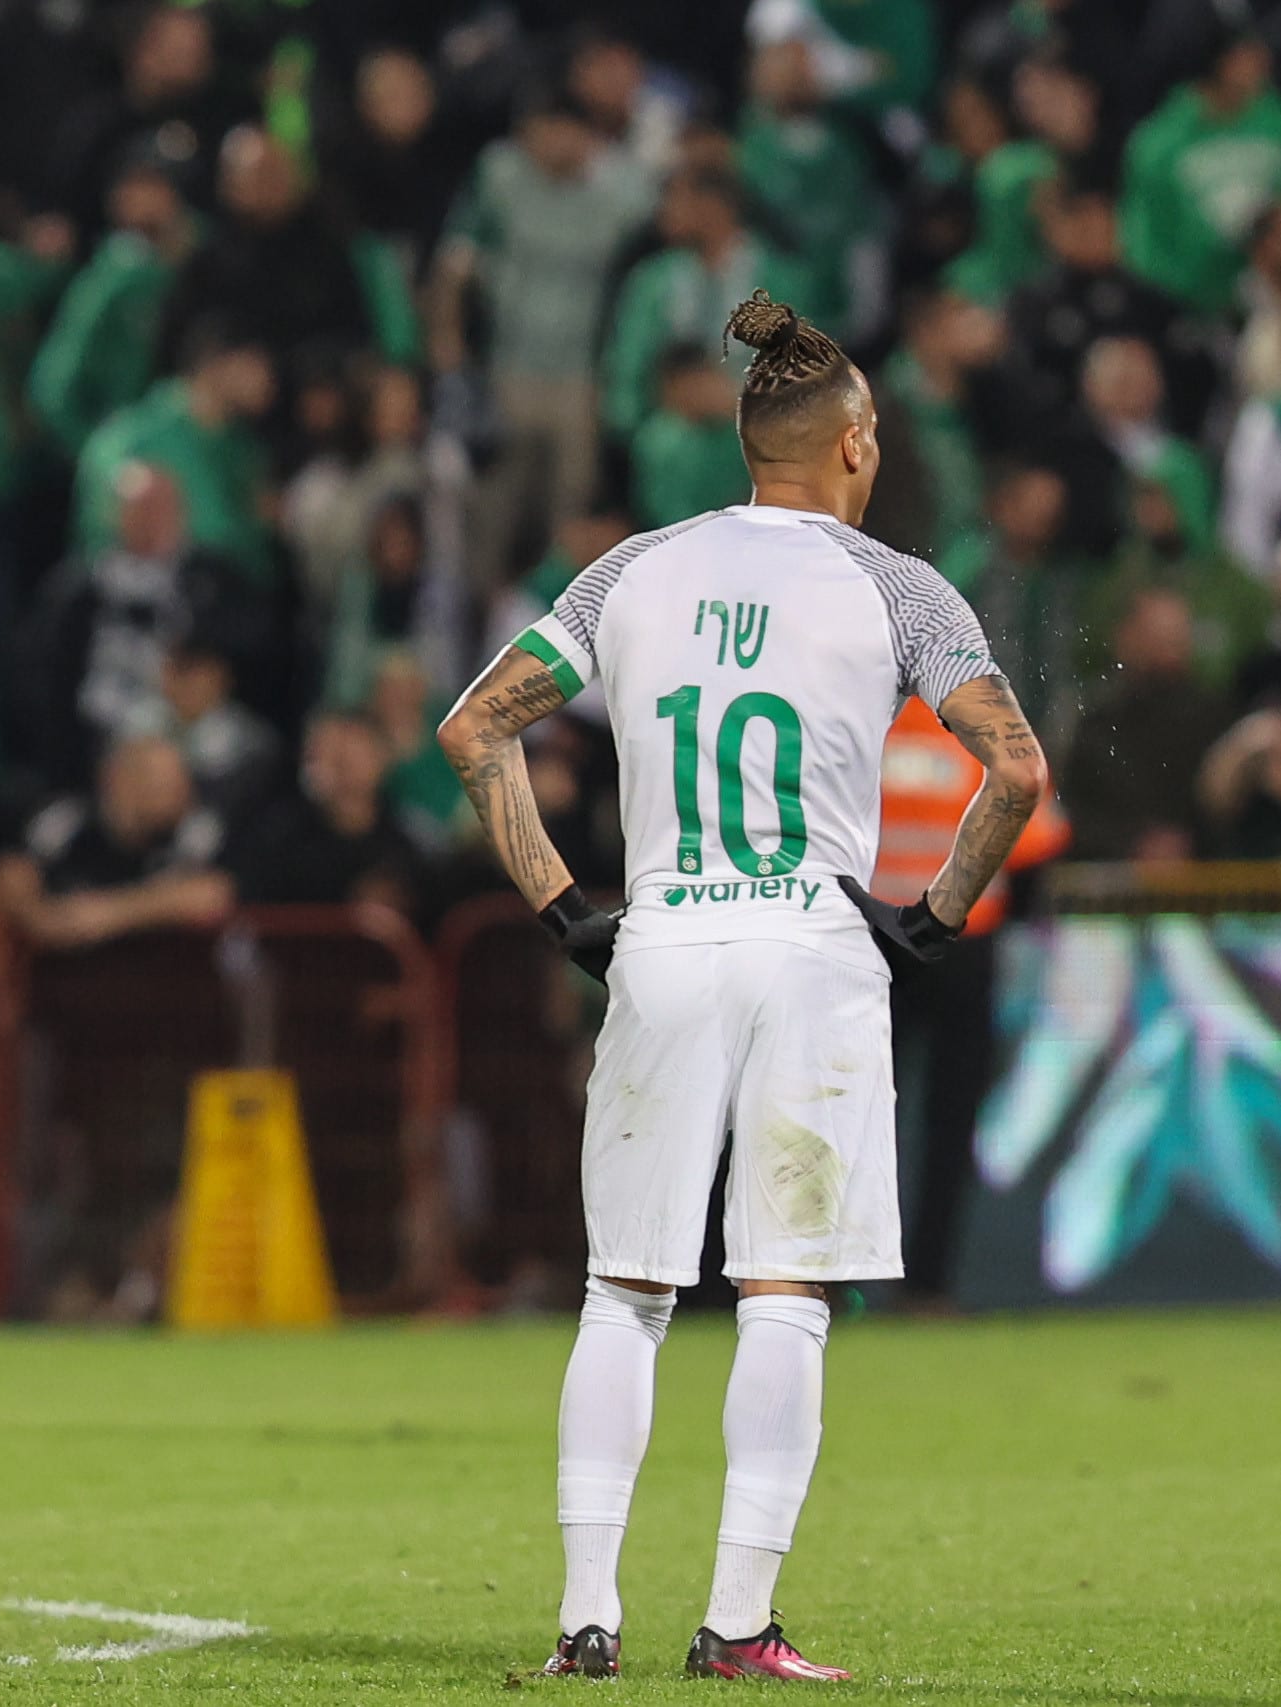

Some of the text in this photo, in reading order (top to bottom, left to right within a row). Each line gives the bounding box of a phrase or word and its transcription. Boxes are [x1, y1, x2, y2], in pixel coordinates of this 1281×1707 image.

[693, 599, 770, 669] שרי
[656, 684, 809, 878] 10
[689, 876, 822, 911] variety
